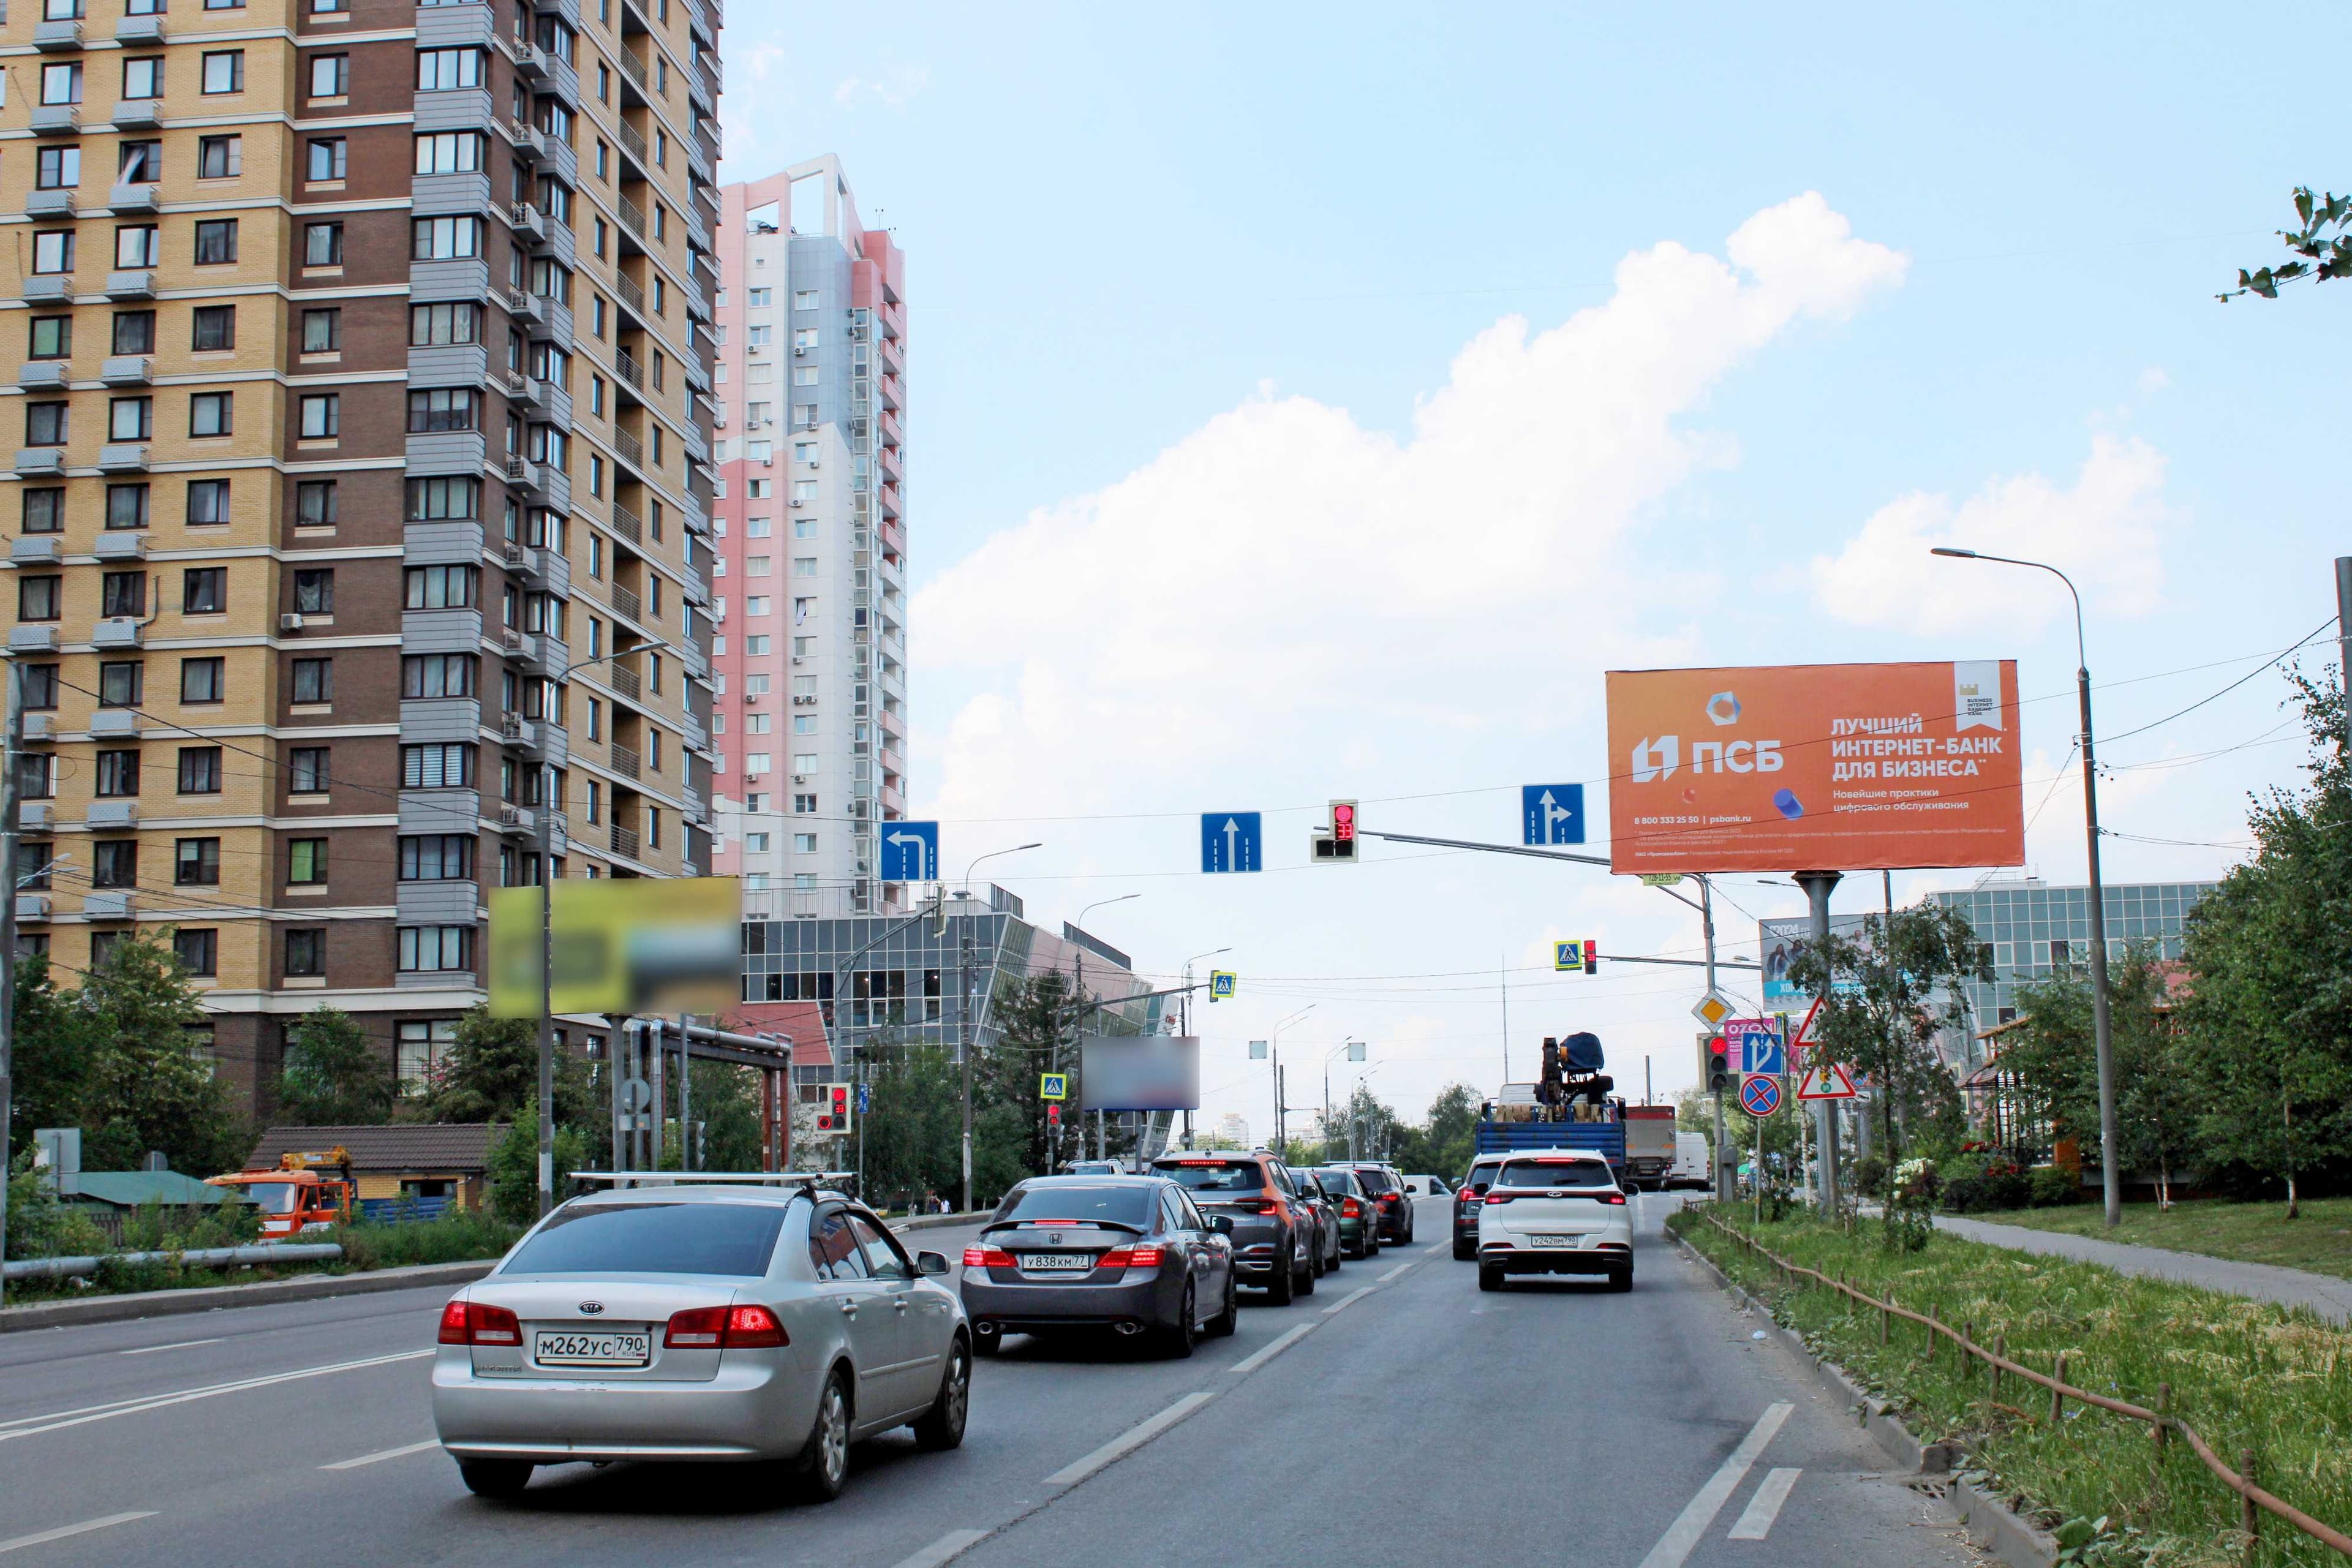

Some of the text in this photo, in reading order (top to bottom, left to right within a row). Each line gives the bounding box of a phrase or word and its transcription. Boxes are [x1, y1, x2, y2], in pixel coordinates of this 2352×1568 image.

[1831, 713, 1923, 735] ЛУЧШИЙ
[1832, 737, 2003, 757] ИНТЕРНЕТ-БАНК
[1693, 740, 1783, 774] ПСБ
[1832, 762, 1876, 782] ДЛЯ
[1833, 788, 1939, 799] Новейшие практики
[1833, 801, 1969, 813] цифрового обслуживания
[1709, 815, 1751, 824] psbank.ru
[1338, 823, 1352, 839] 33
[1028, 1256, 1085, 1267] У838КМ 77
[541, 1336, 643, 1355] М262УС 790
